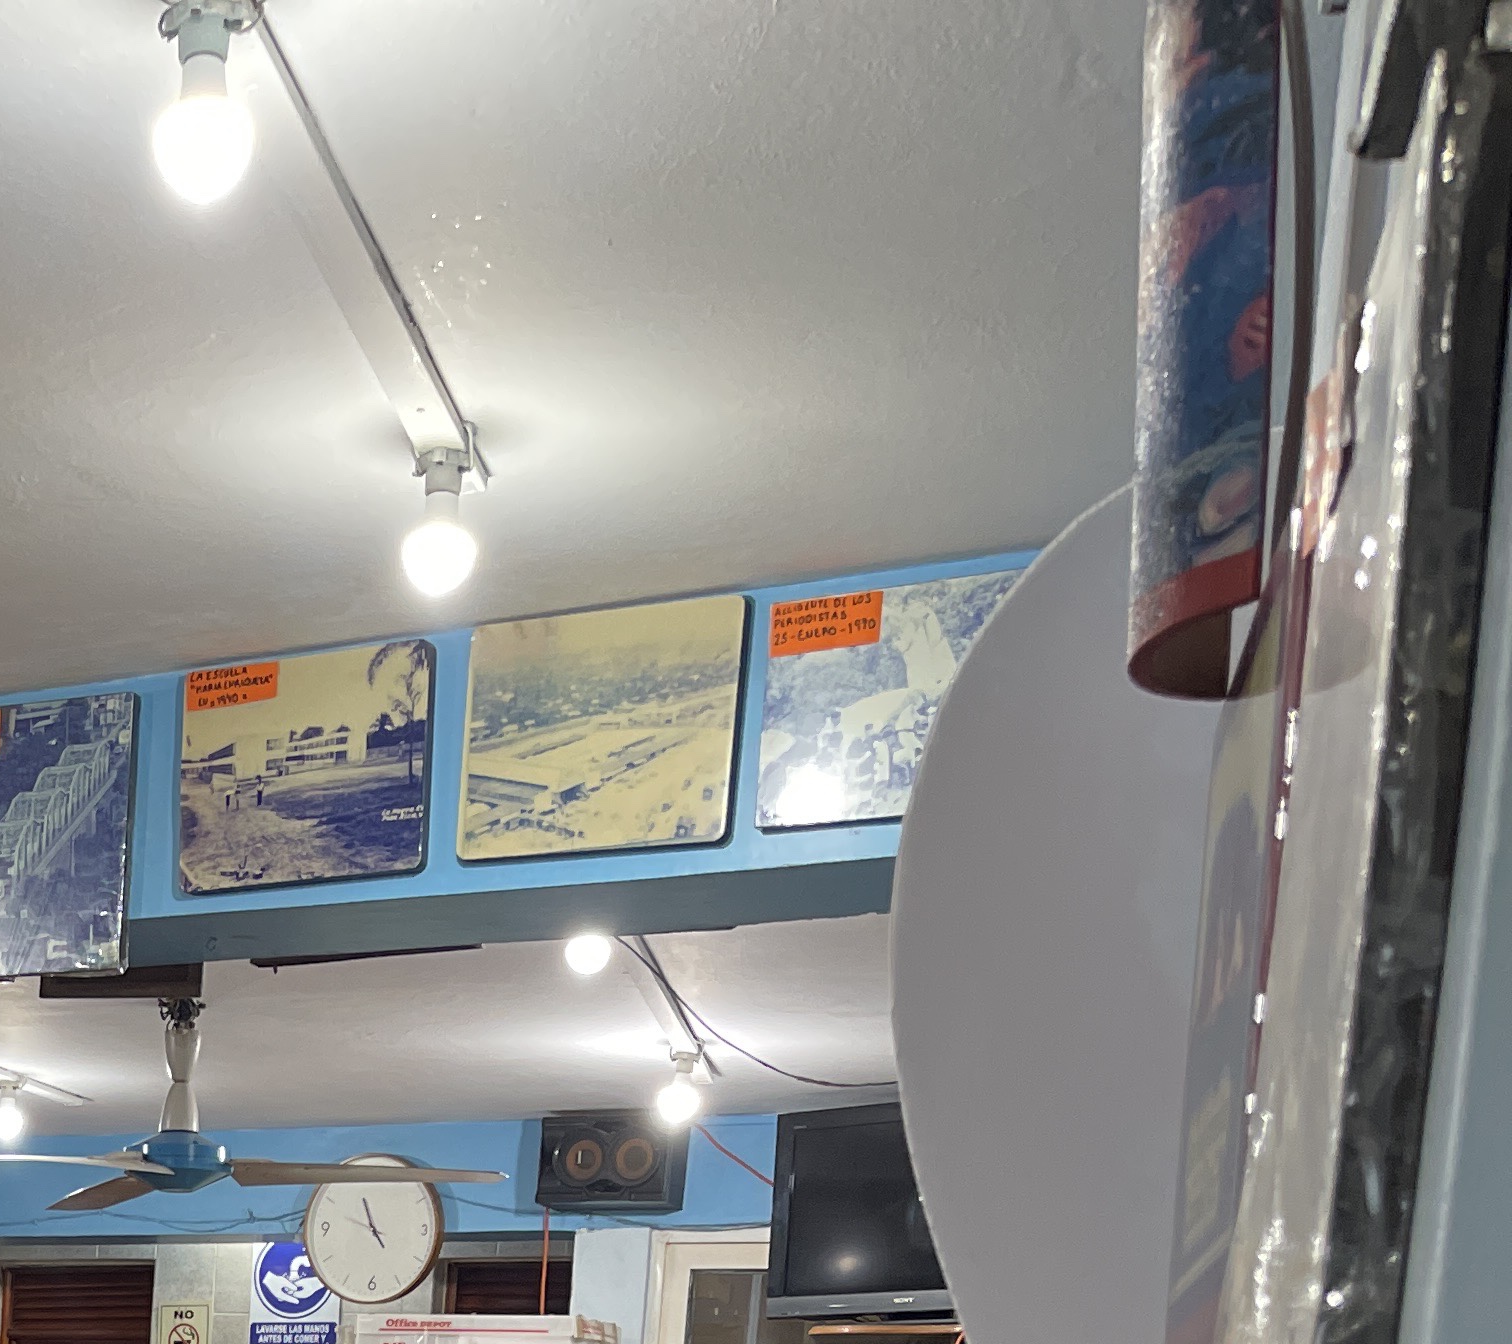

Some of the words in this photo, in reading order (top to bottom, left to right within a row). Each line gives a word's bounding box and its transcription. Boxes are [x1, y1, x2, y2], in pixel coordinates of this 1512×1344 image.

[321, 1221, 330, 1237] 9
[421, 1224, 428, 1236] 3
[368, 1275, 376, 1291] 6
[174, 1310, 194, 1319] NO
[386, 1319, 418, 1328] Office
[256, 1324, 287, 1334] LAVARSE
[289, 1324, 302, 1334] LAS
[304, 1324, 329, 1334] MANOS
[258, 1334, 282, 1343] ANTES
[283, 1334, 293, 1343] DE
[294, 1334, 319, 1343] COMER
[321, 1334, 327, 1343] Y
